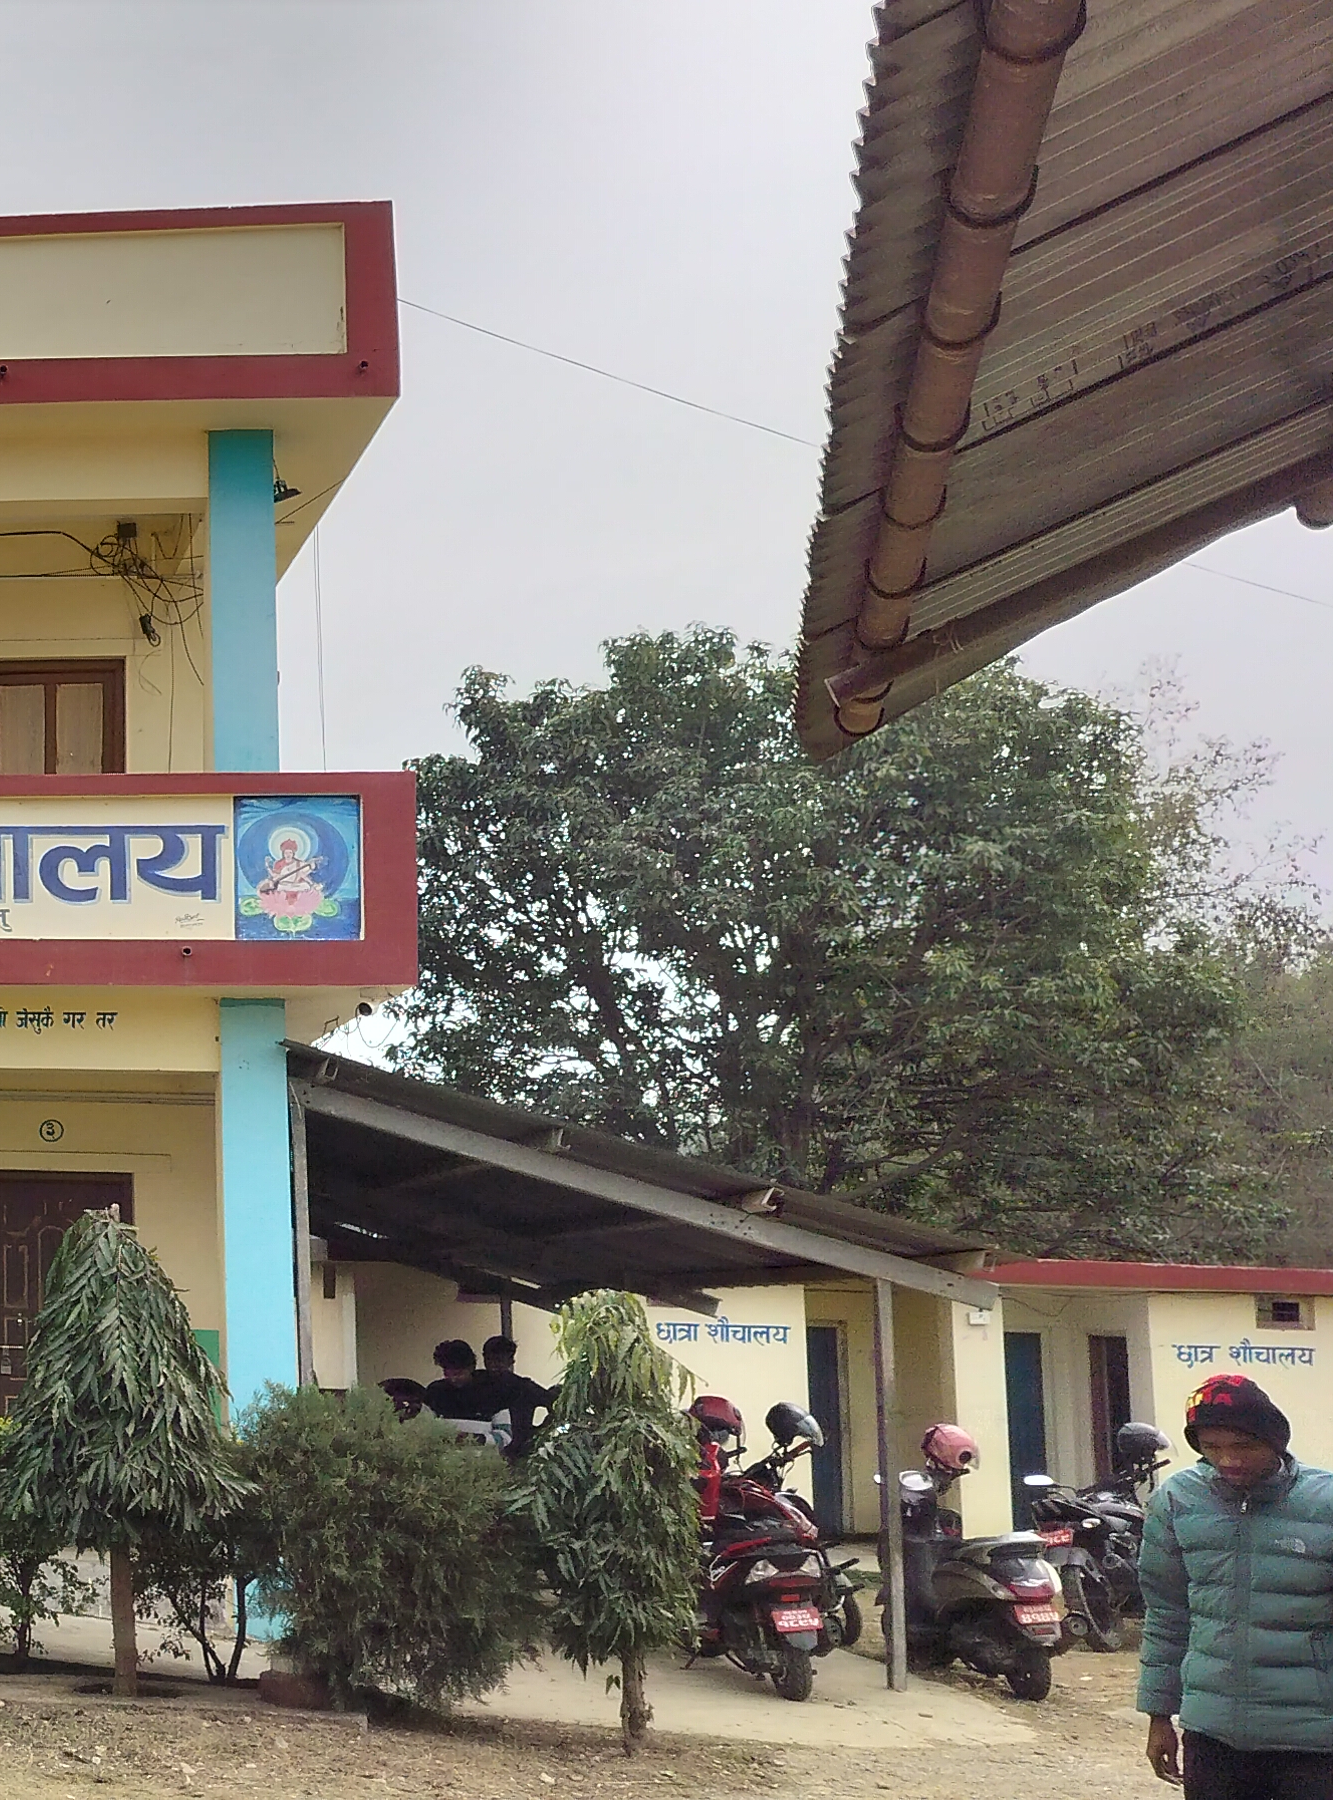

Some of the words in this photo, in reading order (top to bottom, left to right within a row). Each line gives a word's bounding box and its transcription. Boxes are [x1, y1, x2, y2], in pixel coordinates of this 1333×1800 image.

[63, 1012, 86, 1030] गर
[96, 1012, 118, 1031] तर
[656, 1322, 699, 1344] छात्रा
[705, 1316, 791, 1346] शौचालय
[1172, 1344, 1221, 1368] छात्र
[1229, 1338, 1316, 1369] शौचालय
